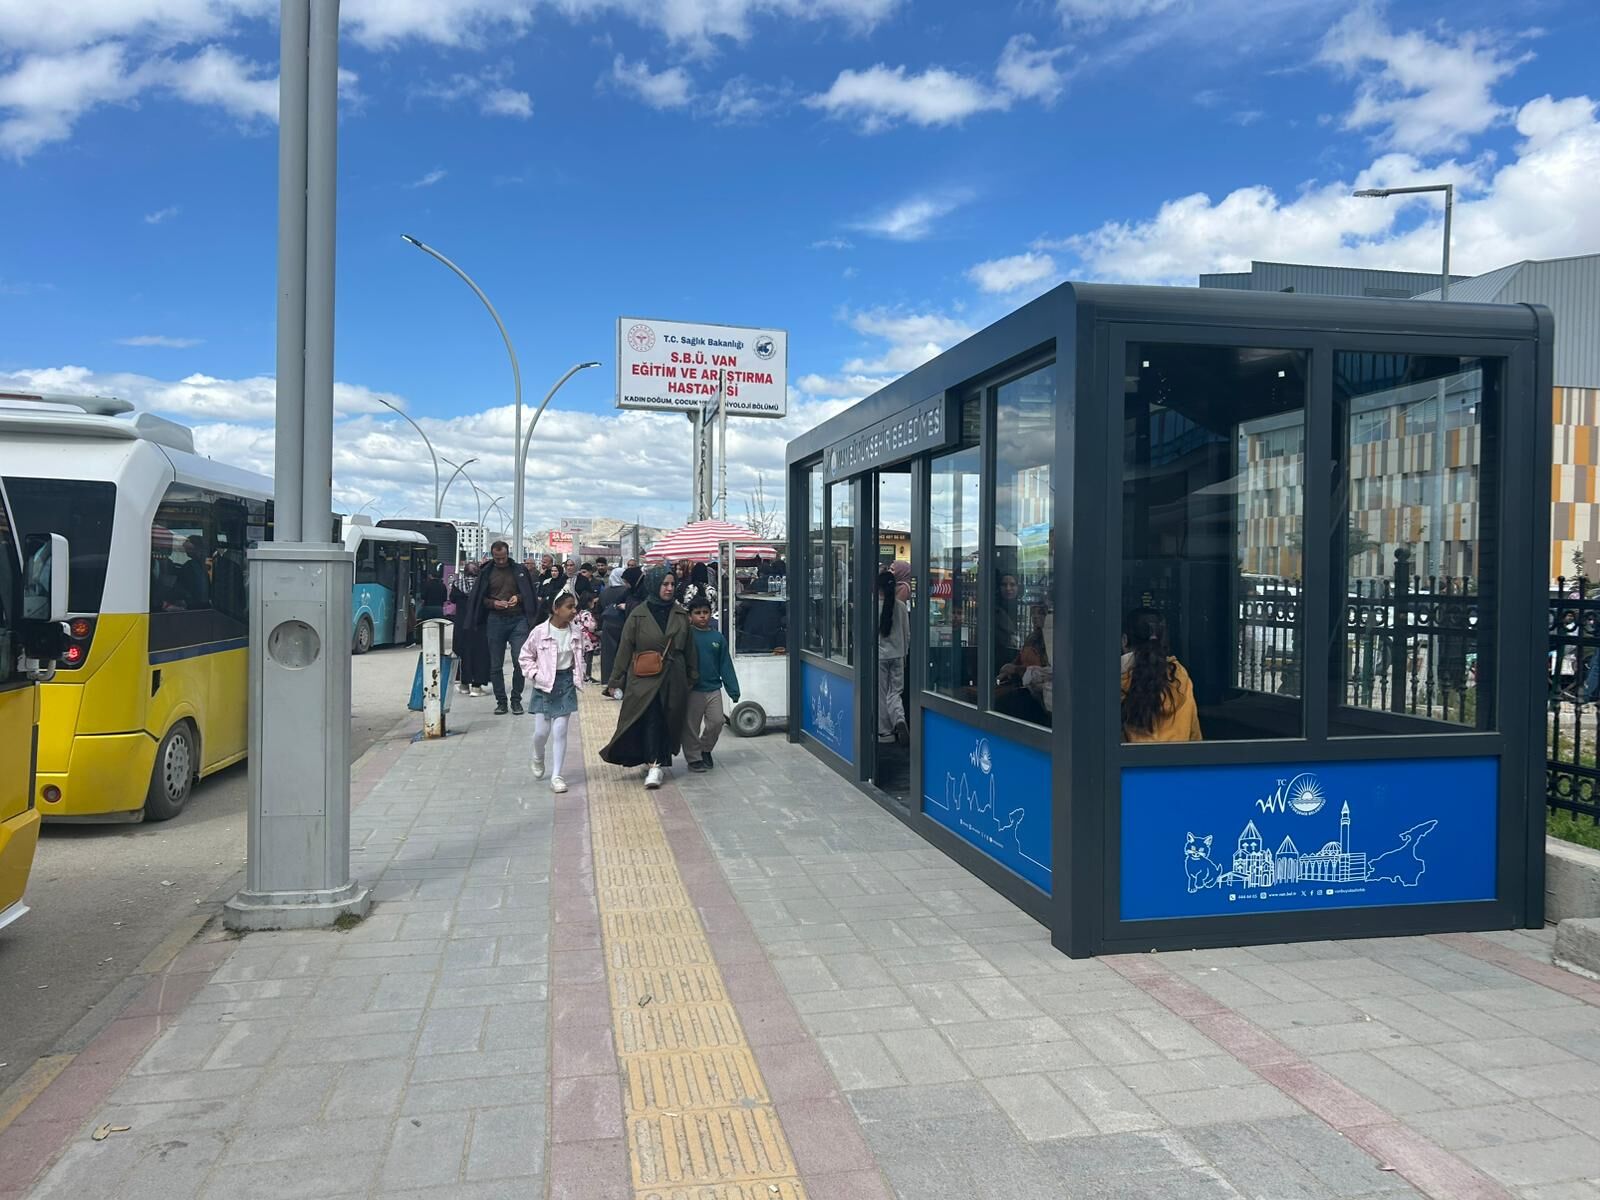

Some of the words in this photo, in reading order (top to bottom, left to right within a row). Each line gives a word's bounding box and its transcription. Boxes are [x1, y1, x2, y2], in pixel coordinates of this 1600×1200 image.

[664, 335, 679, 344] T.C.
[680, 336, 706, 347] Sağlık
[707, 338, 744, 350] Bakanlığı
[671, 350, 708, 365] S.B.Ü.
[711, 354, 737, 367] VAN
[631, 361, 677, 378] EĞİTİM
[680, 367, 697, 379] VE
[701, 368, 773, 384] ARŞTIRMA
[668, 382, 739, 397] HASTANSİ
[624, 395, 646, 403] KADIN
[646, 396, 673, 405] DOĞUM,
[752, 402, 779, 411] BÖLÜMÜ
